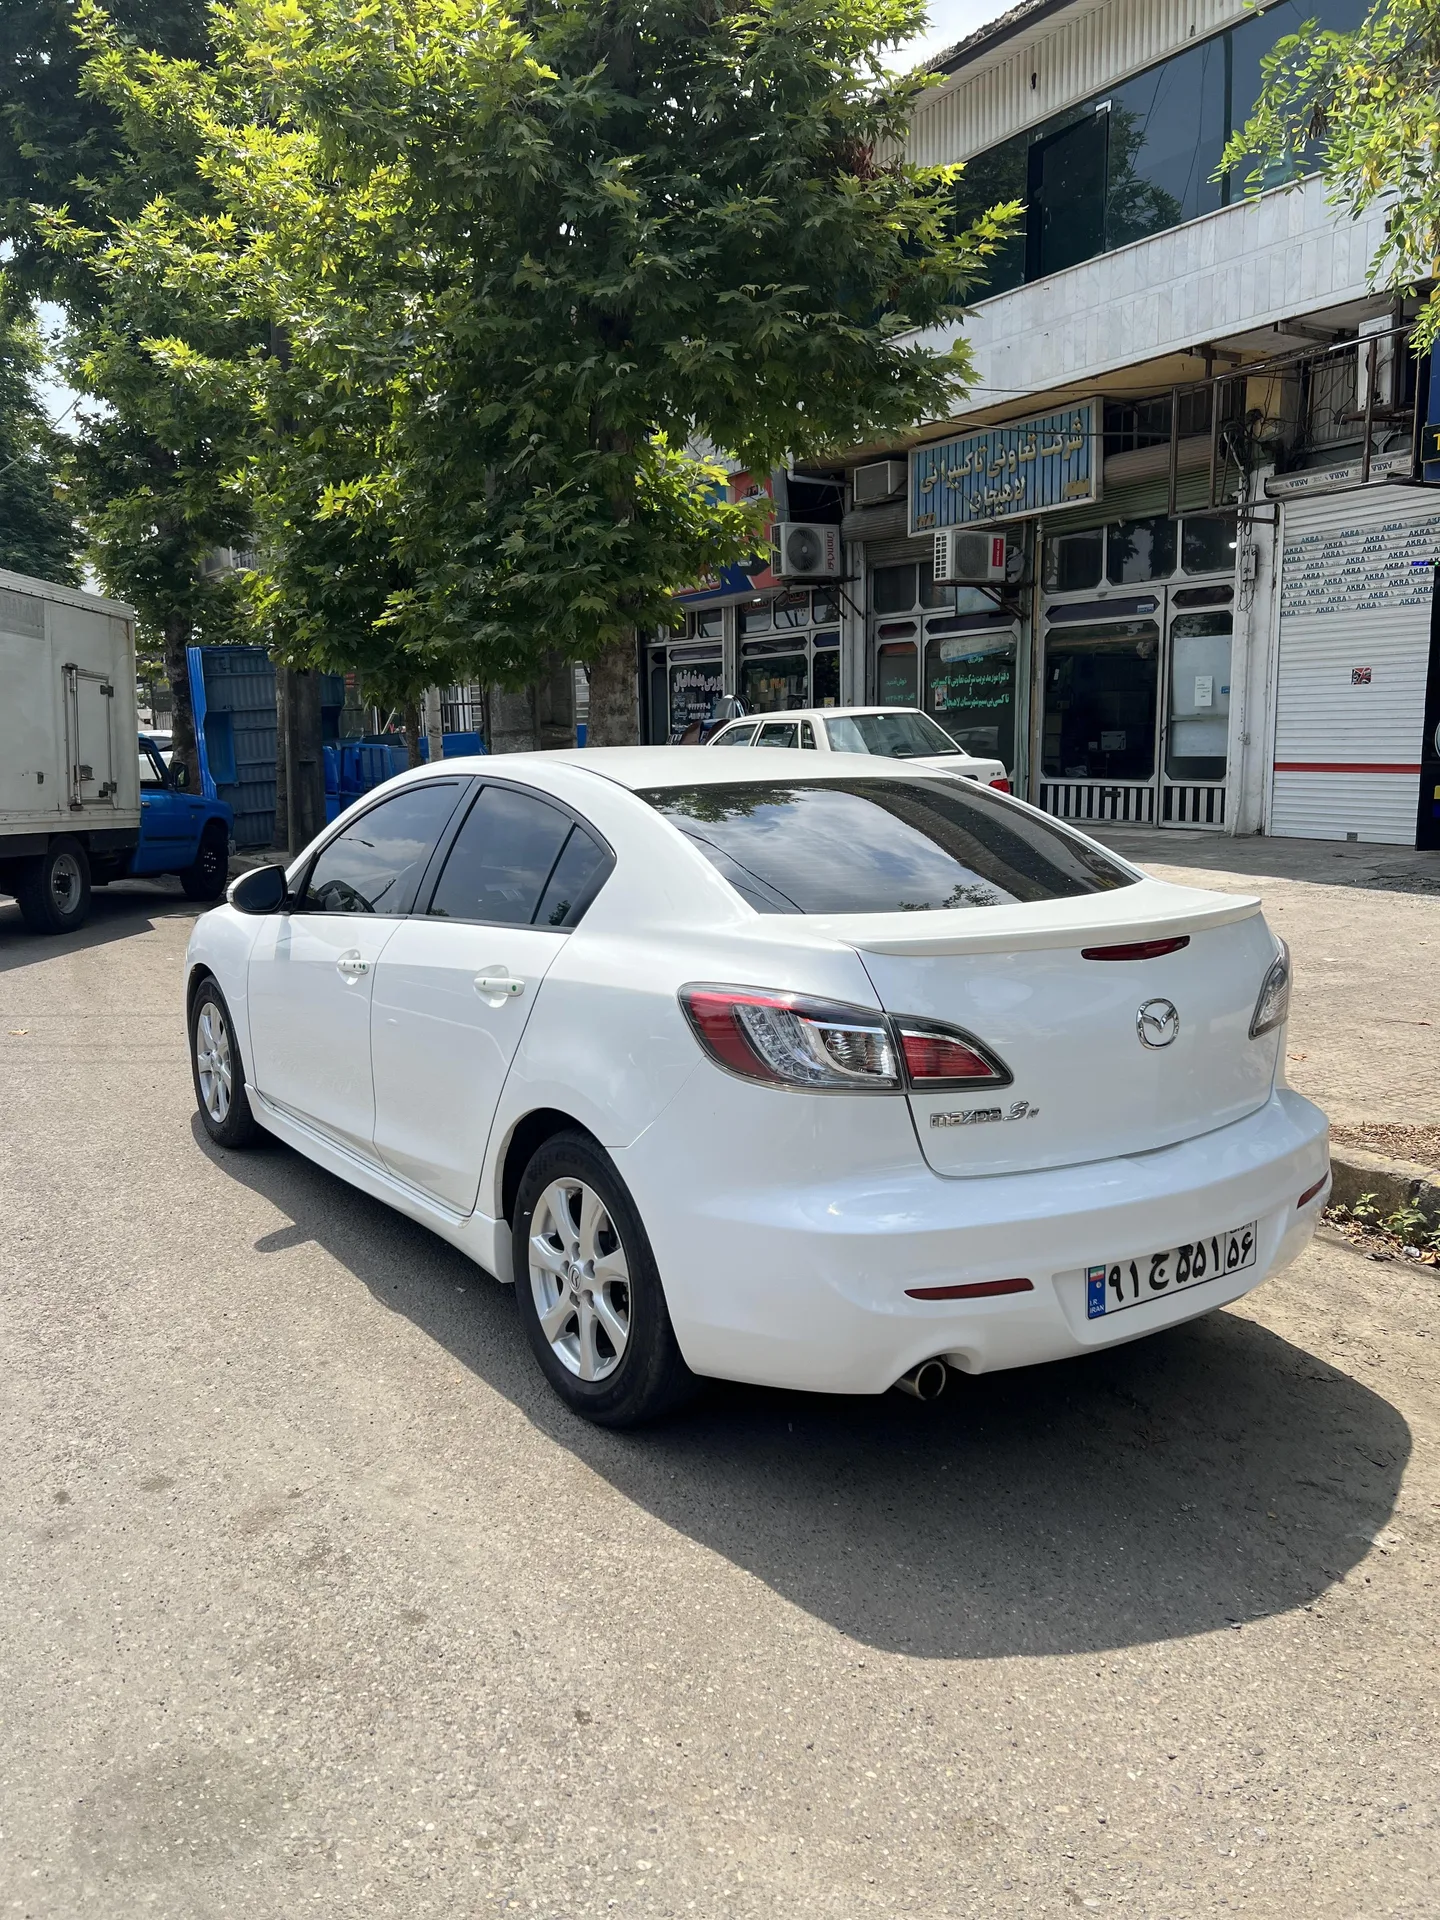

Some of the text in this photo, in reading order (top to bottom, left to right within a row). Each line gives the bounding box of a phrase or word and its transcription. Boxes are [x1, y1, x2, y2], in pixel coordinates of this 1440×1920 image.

[920, 417, 1084, 494] شرکت تعاونی تاکسیرانی
[1329, 470, 1349, 480] AKRA
[1371, 461, 1393, 471] AKRA
[1289, 478, 1309, 487] AKRA
[970, 475, 1026, 513] لاهیجان
[1301, 517, 1440, 544] AKRA AKRA AKRA AKR
[1285, 528, 1430, 555] AKRA AKRA AKRA AKRA
[1284, 539, 1427, 564] AKRA AKRA AKRA AKRA
[1306, 551, 1409, 570] AKRA AKRA AKRA
[1285, 582, 1303, 590] AKRA
[1364, 572, 1384, 581] AKRA
[1408, 567, 1429, 576] AKRA
[1302, 572, 1320, 580] AKRA
[1341, 567, 1361, 575] AKRA
[1383, 562, 1405, 570] AKRA
[1306, 579, 1409, 596] AKRA AKRA AKRA
[1368, 591, 1388, 599] AKRA
[1412, 586, 1433, 594] AKRA
[1316, 606, 1335, 614] AKRA
[1356, 602, 1376, 610] AKRA
[1399, 597, 1420, 605] AKRA
[1090, 1303, 1105, 1314] IRAN
